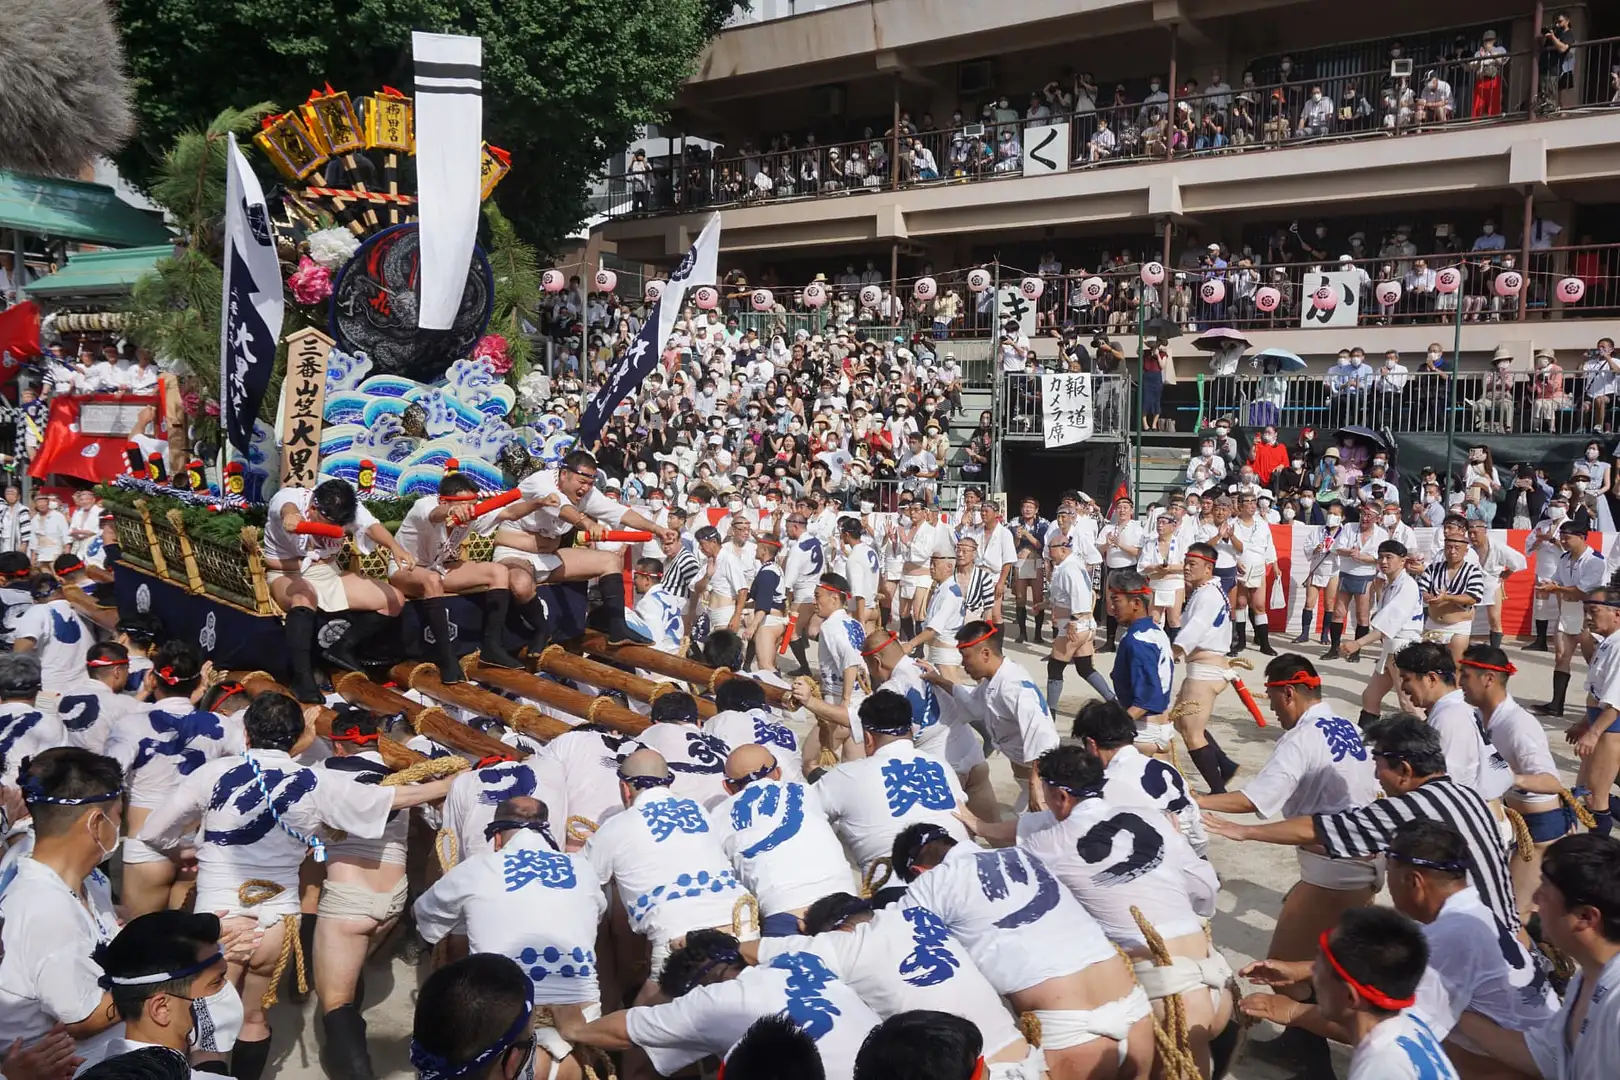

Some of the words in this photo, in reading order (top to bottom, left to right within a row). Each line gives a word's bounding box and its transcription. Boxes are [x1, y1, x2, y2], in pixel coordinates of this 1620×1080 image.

[1030, 128, 1057, 170] く
[283, 339, 323, 489] 三番山笠大黒
[1048, 376, 1065, 443] カメラ席
[1065, 375, 1089, 429] 報道
